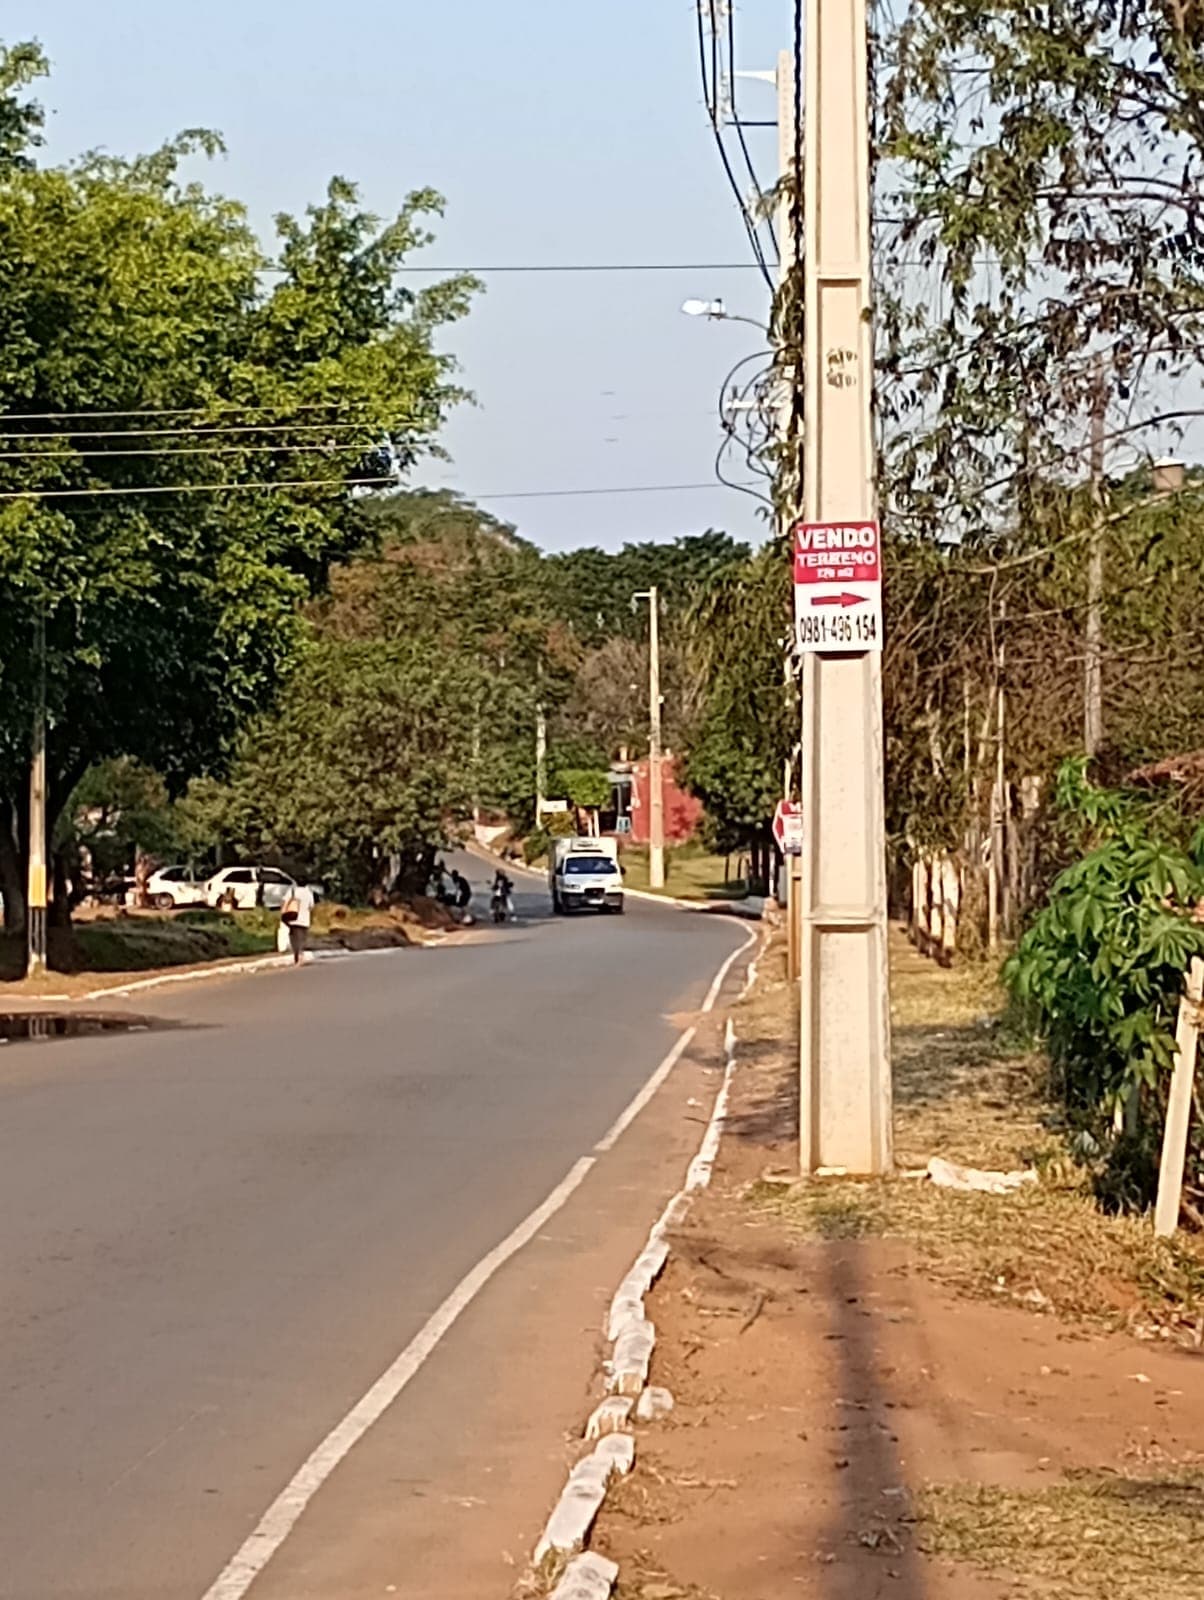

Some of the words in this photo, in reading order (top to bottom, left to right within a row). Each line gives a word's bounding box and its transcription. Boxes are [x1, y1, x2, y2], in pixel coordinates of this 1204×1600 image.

[797, 527, 876, 550] VENDO
[797, 551, 876, 568] TERRENO
[856, 612, 876, 641] 154
